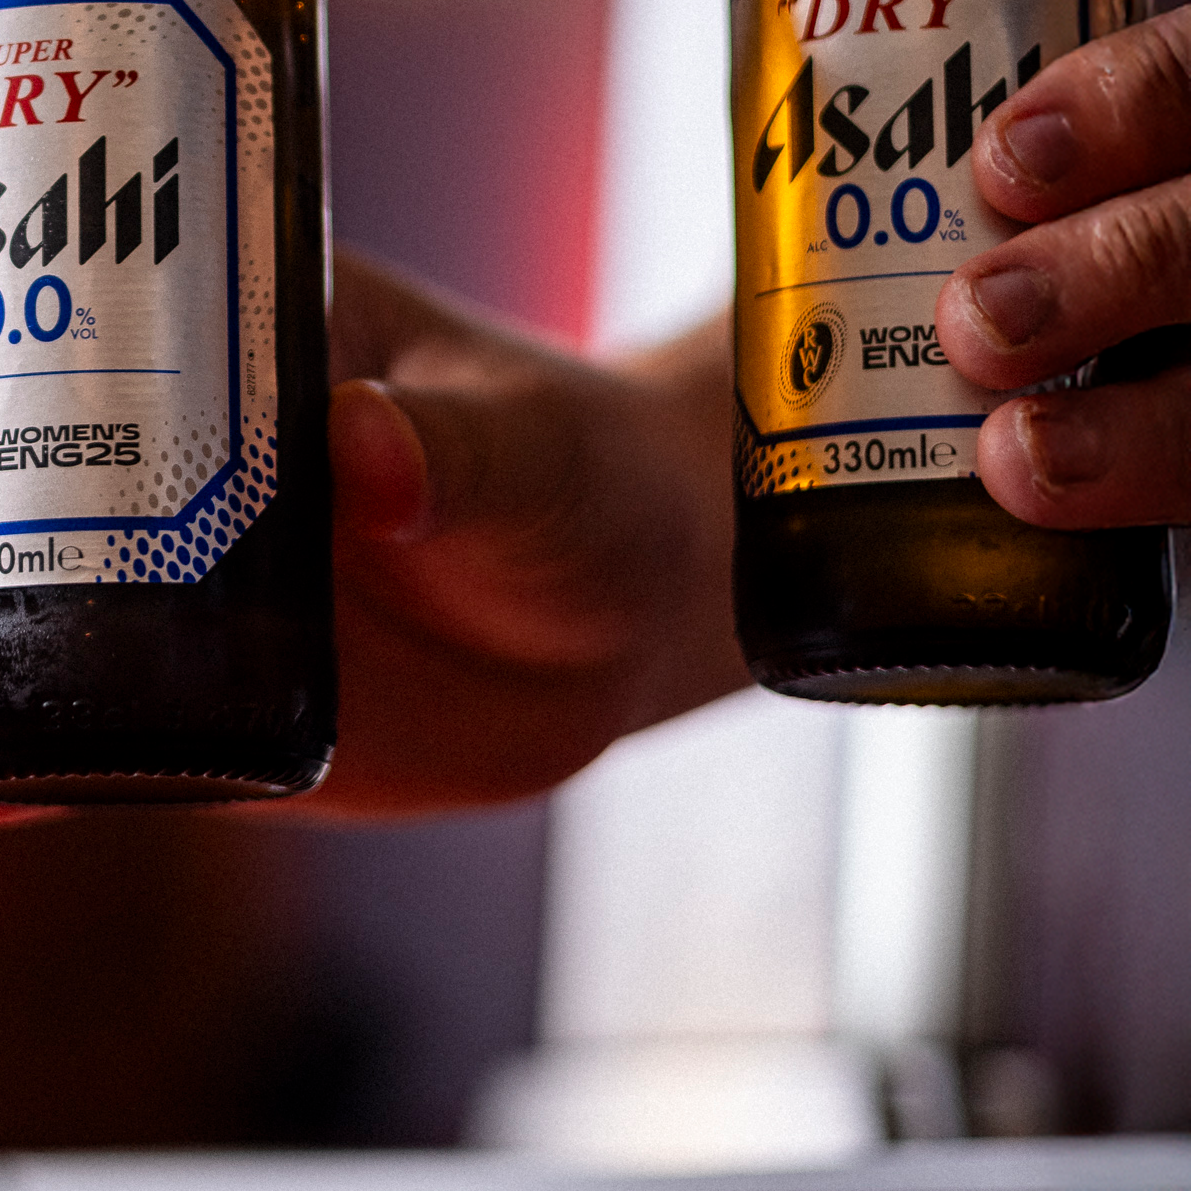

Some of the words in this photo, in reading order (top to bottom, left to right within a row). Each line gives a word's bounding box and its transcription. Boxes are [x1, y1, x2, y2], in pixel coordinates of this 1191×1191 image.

[807, 240, 828, 254] ALC
[939, 228, 967, 242] VOL
[70, 328, 99, 341] VOL
[862, 342, 950, 370] ENG
